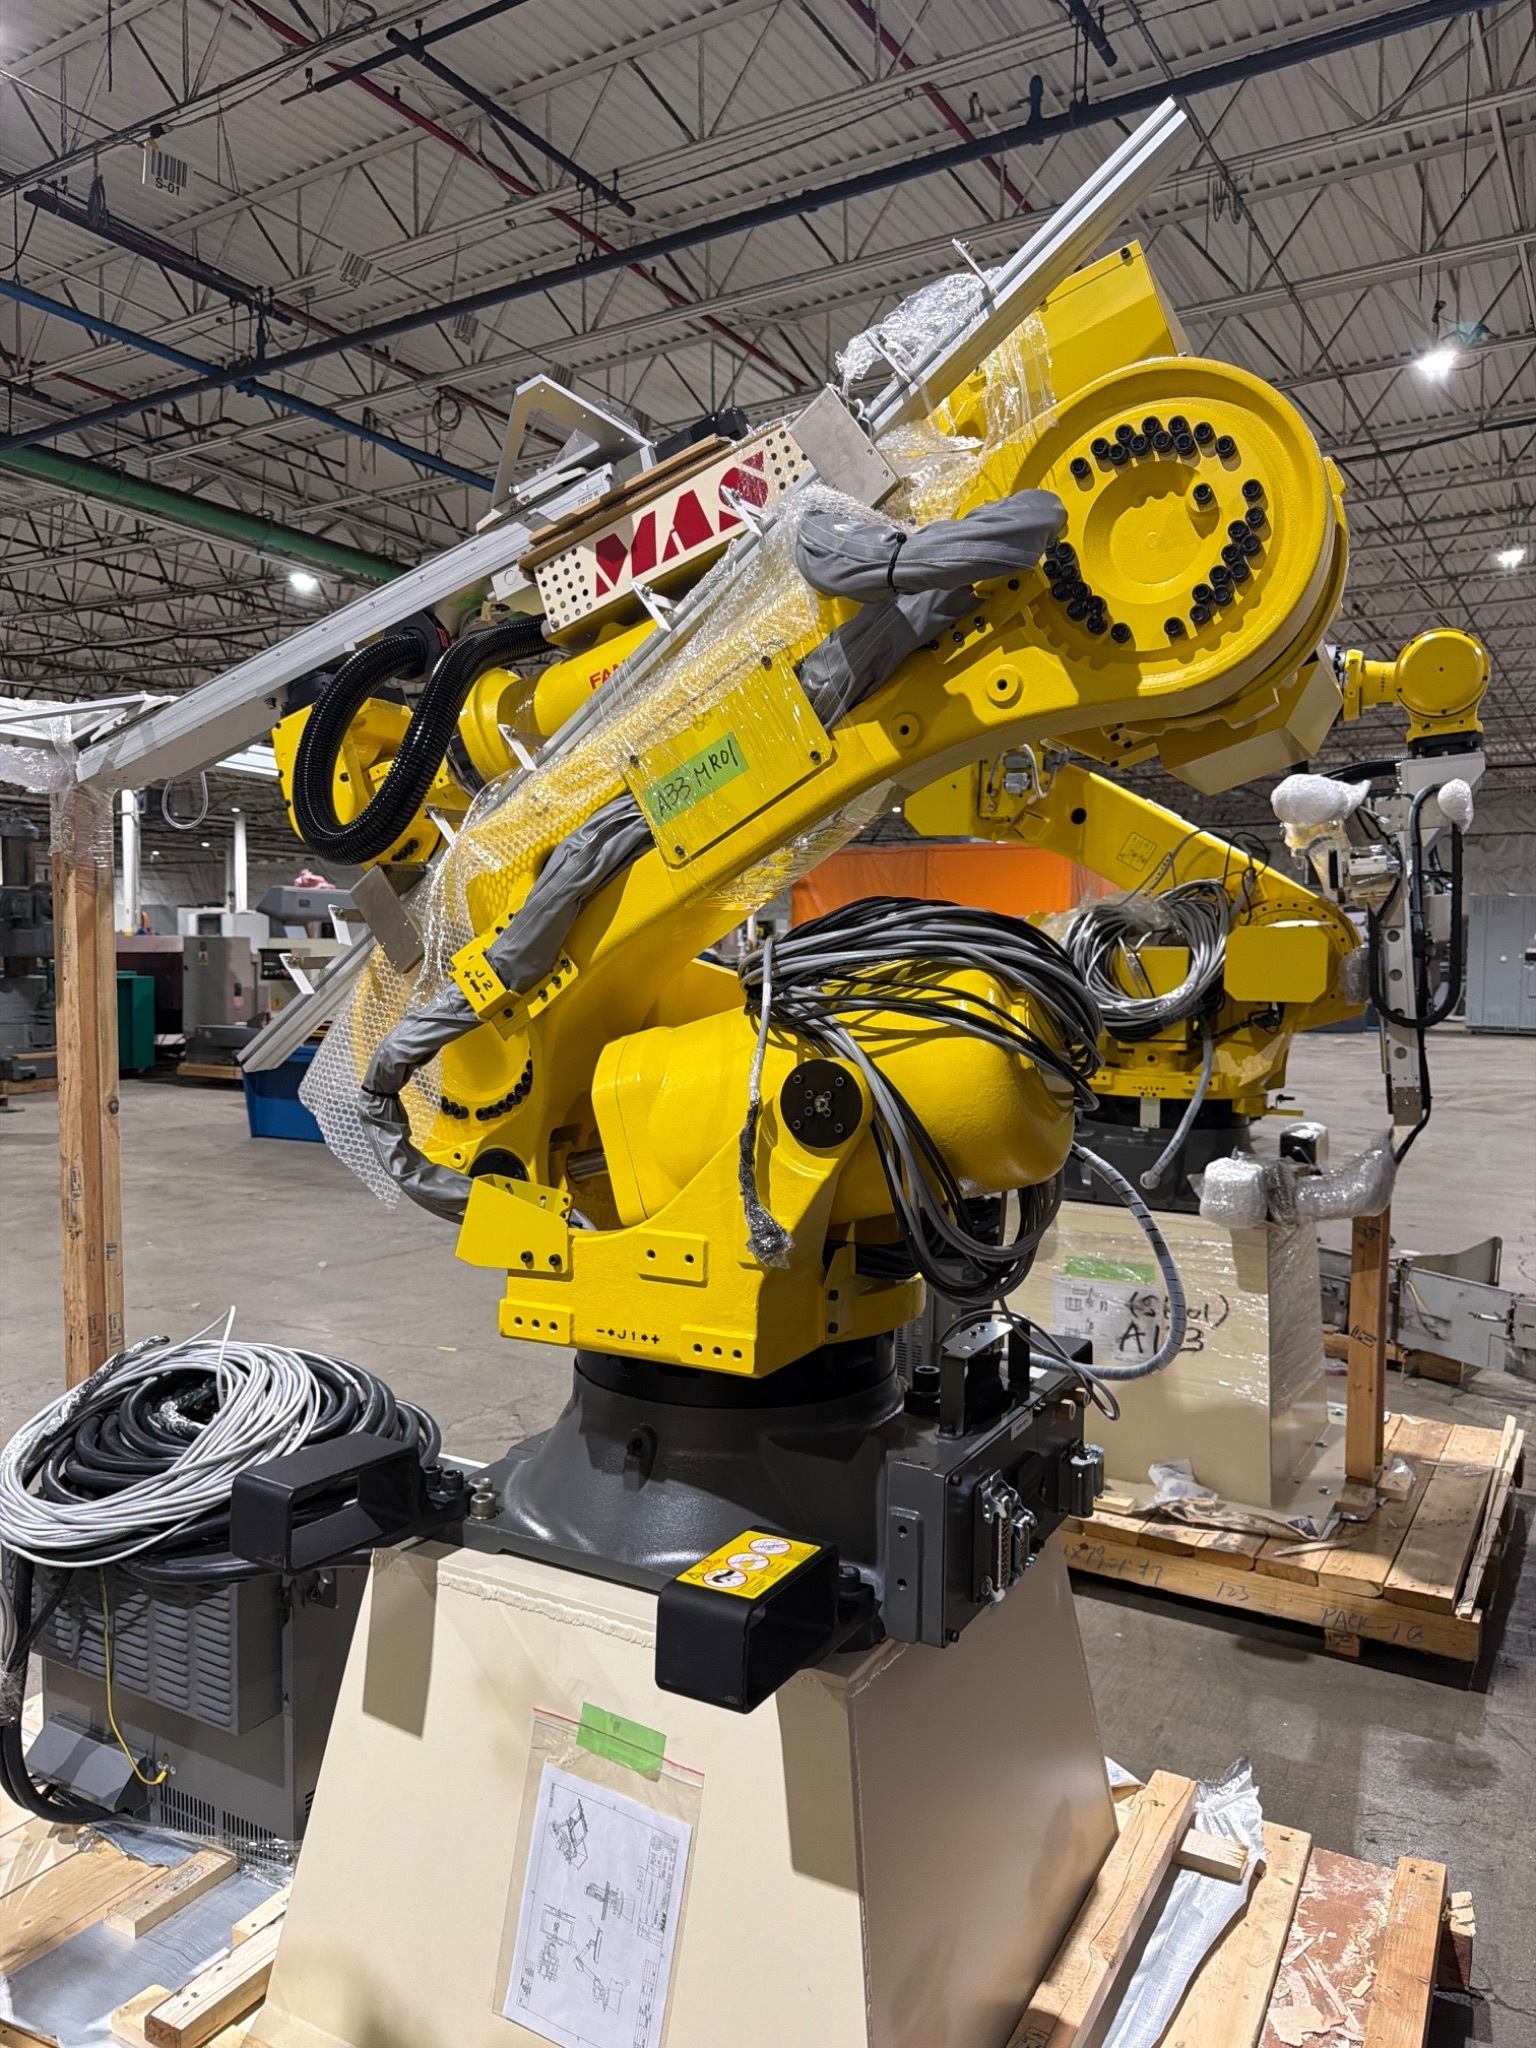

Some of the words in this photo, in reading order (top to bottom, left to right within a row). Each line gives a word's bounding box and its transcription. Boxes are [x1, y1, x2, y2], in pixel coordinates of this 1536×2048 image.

[155, 177, 181, 197] S-01
[339, 272, 361, 290] S-02
[595, 450, 769, 599] MAS
